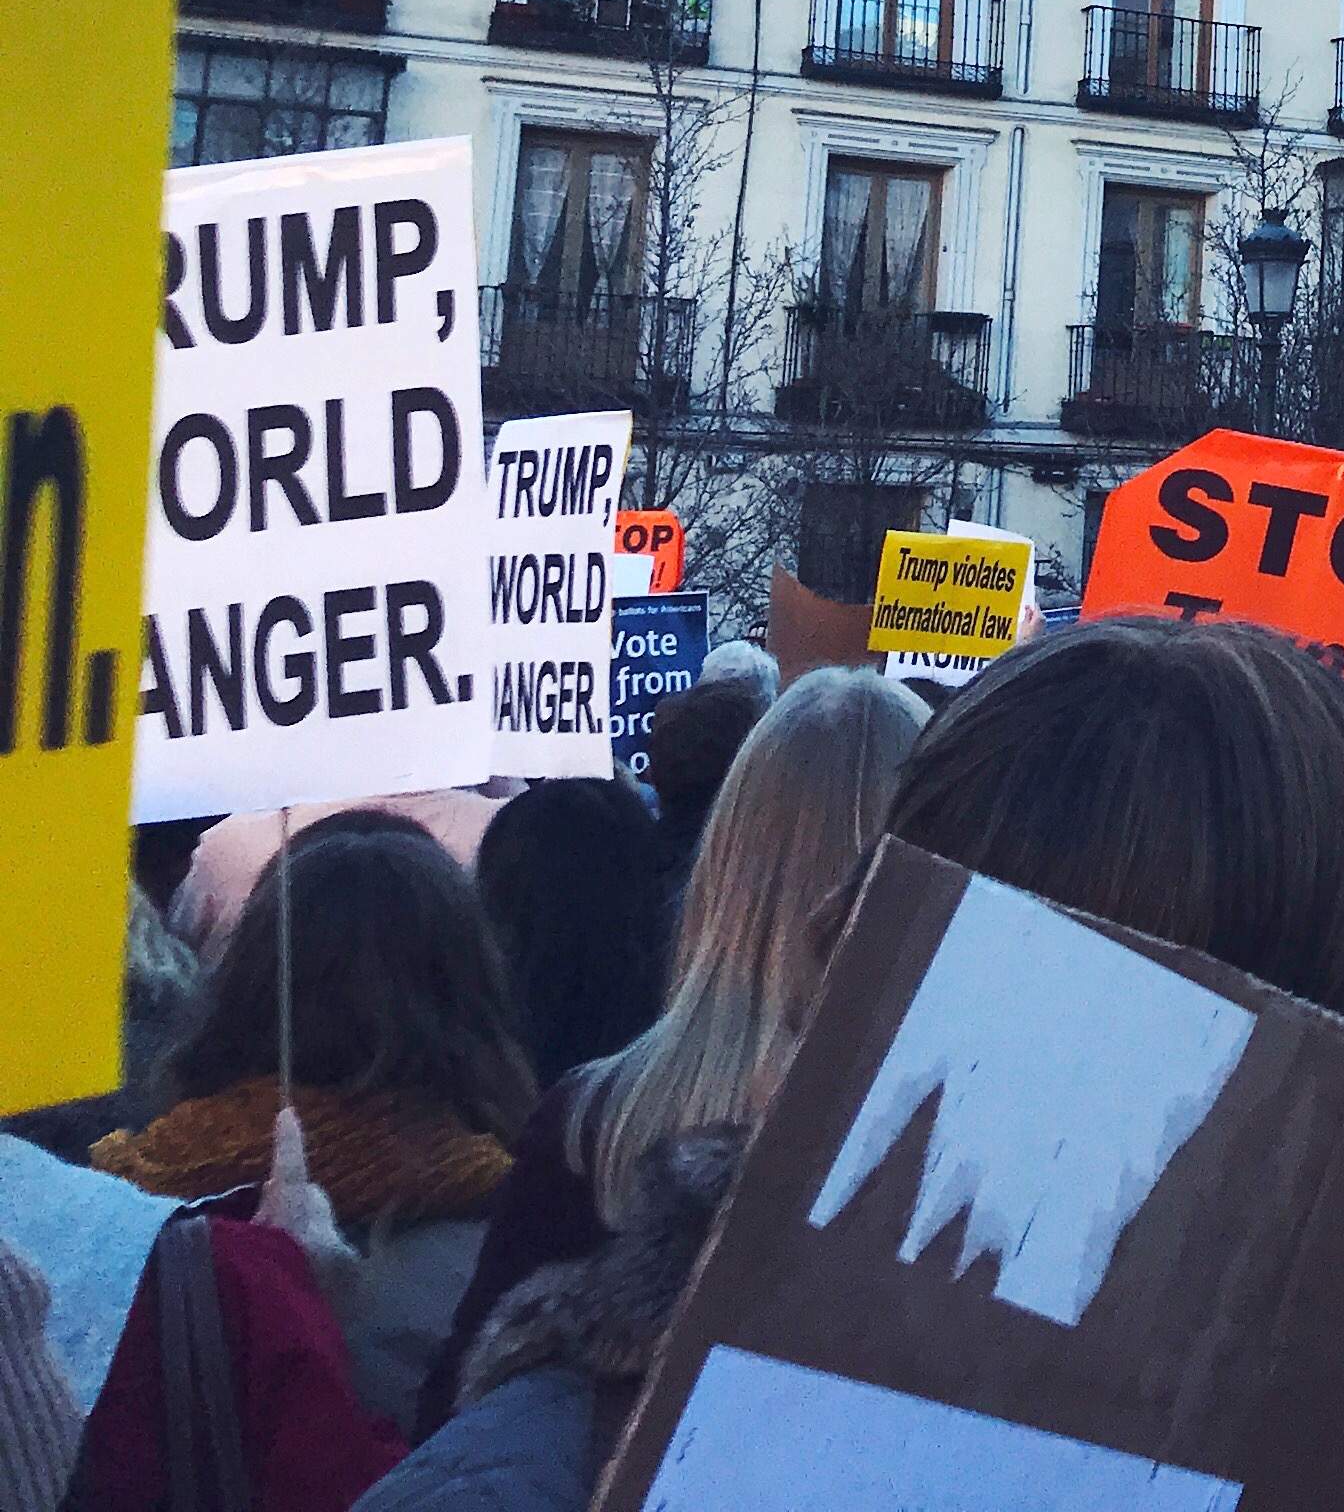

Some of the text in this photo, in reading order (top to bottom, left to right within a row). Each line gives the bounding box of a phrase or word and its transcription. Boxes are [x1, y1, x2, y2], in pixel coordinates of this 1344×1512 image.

[159, 387, 462, 542] ORLD
[497, 444, 613, 528] TRUMP,
[615, 524, 673, 554] OP
[489, 551, 607, 625] WORLD
[896, 547, 1017, 593] Trump violates
[874, 594, 1014, 641] international law.
[610, 630, 678, 660] Vote
[493, 660, 604, 734] ANGER.
[615, 665, 692, 706] from
